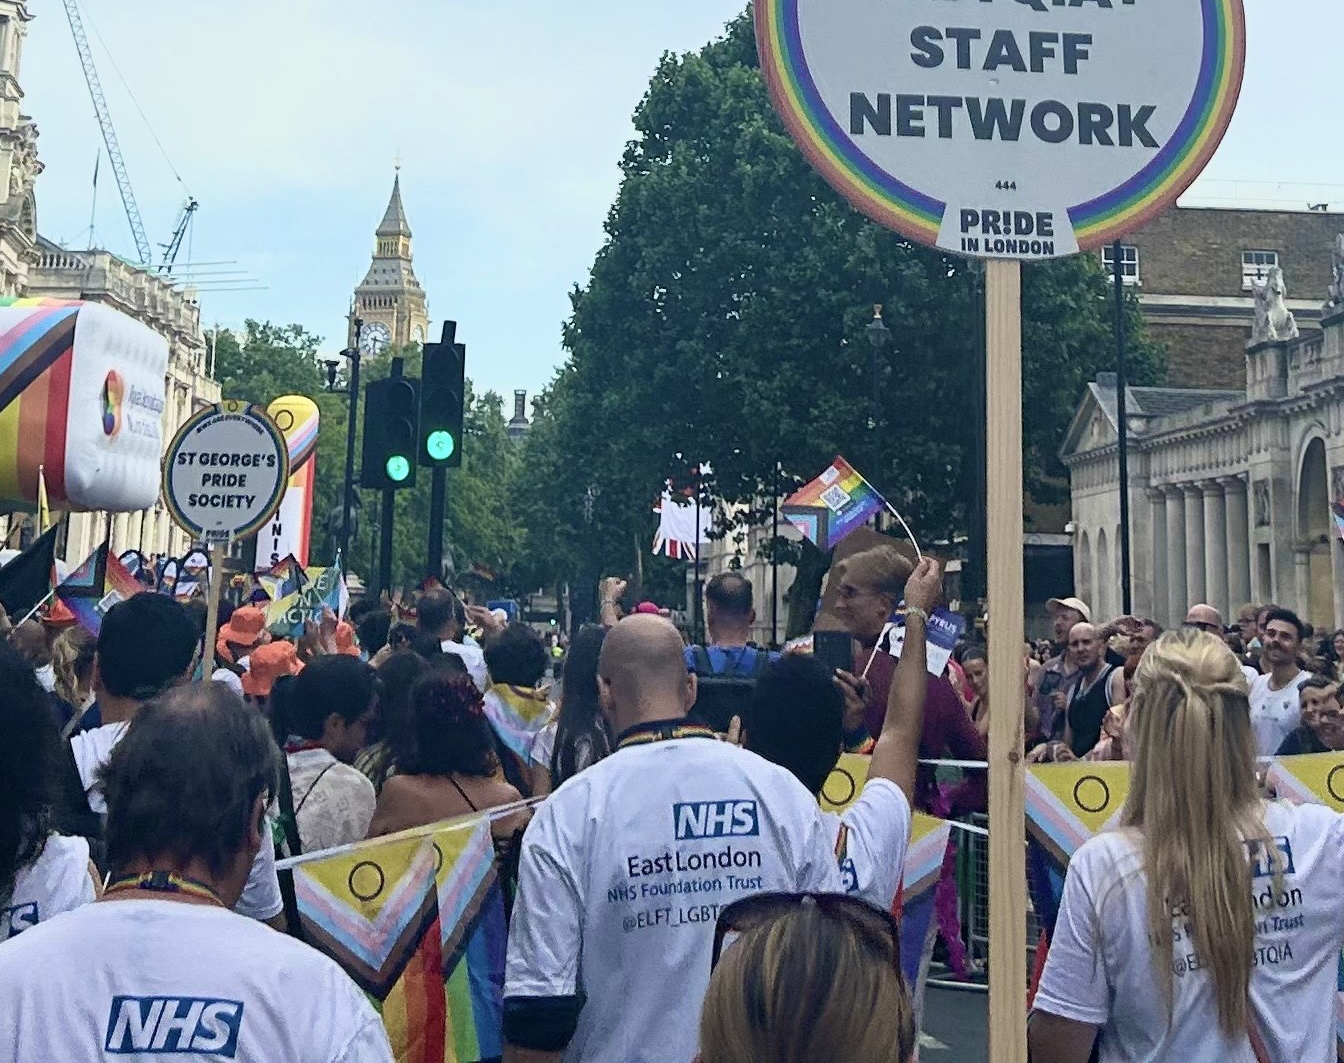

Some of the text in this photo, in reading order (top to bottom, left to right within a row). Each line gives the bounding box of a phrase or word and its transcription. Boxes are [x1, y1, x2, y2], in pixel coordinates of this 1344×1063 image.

[910, 25, 1093, 75] STAFF
[849, 91, 1160, 148] NETWORK
[995, 180, 1017, 191] 444
[961, 237, 1055, 255] IN LONDON
[177, 452, 276, 468] ST GEORGE'S
[201, 473, 248, 487] PRIDE
[188, 493, 256, 509] SOCIETY
[676, 801, 756, 838] NHS
[627, 845, 761, 878] East London
[607, 875, 763, 904] NHS Foundation Trust
[1271, 913, 1305, 932] Trust
[106, 997, 240, 1052] NHS
